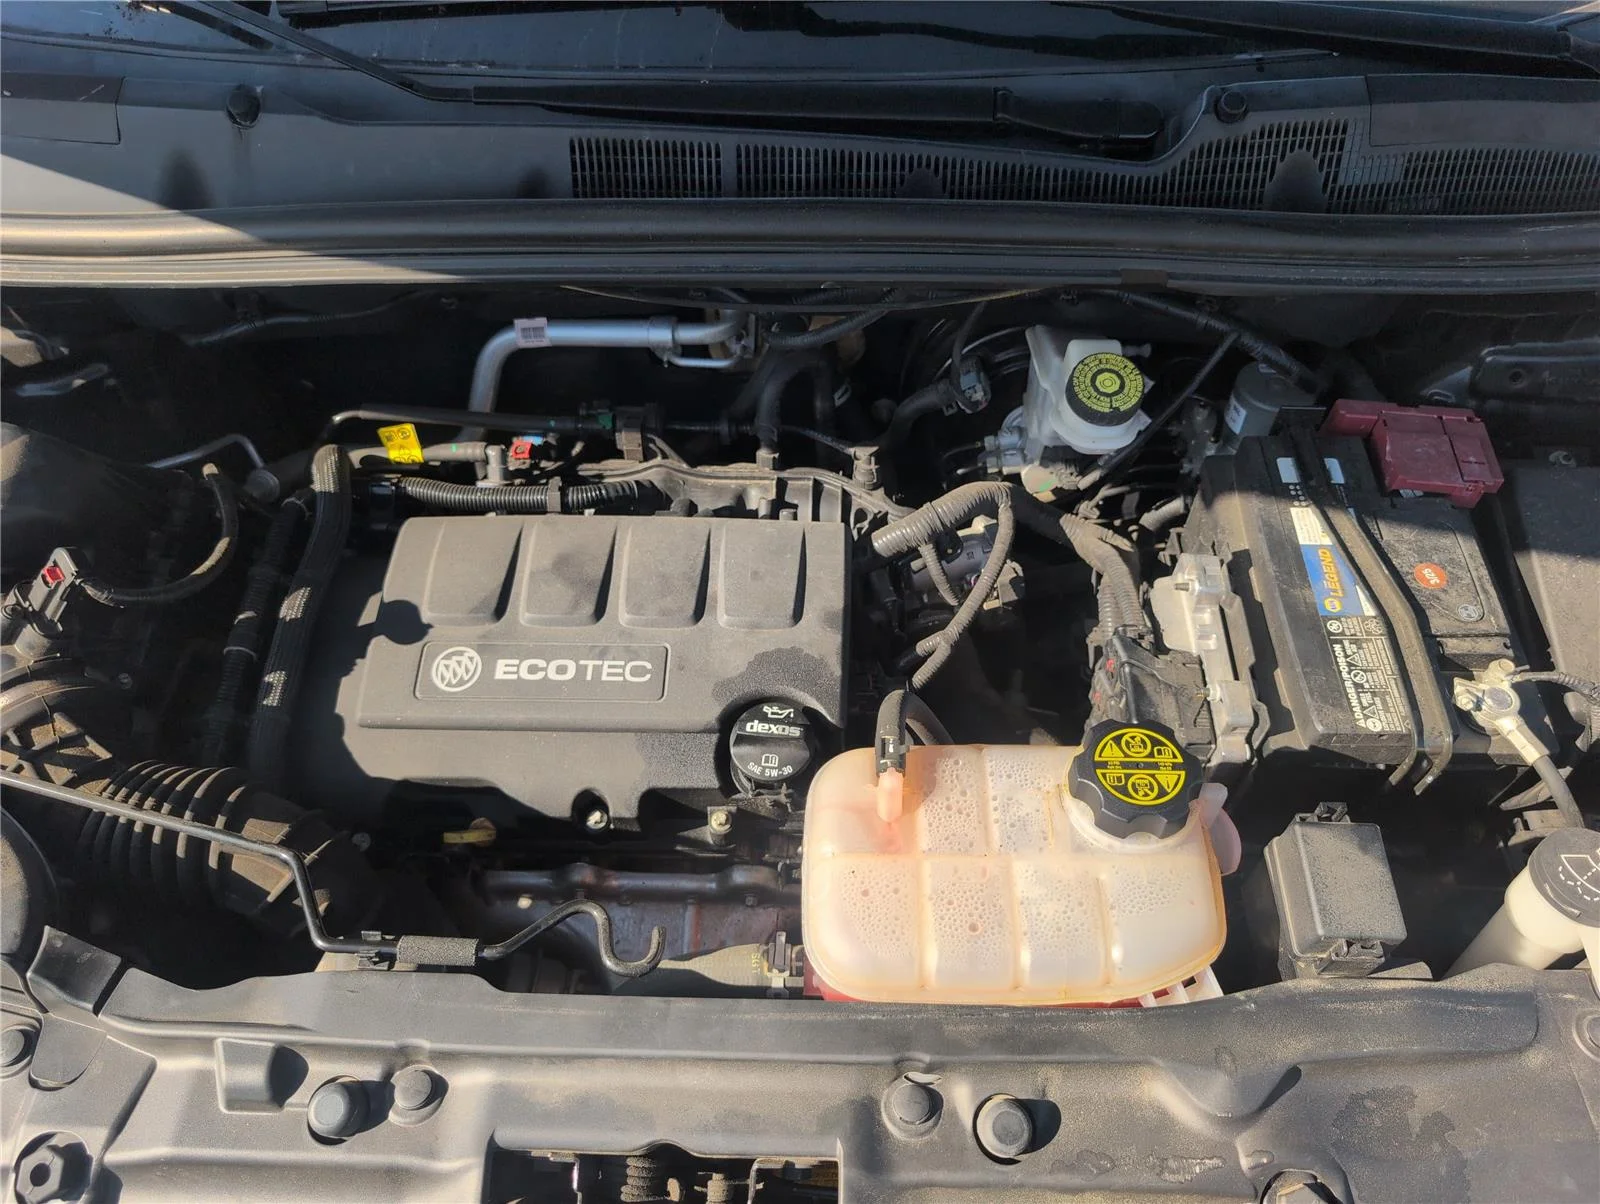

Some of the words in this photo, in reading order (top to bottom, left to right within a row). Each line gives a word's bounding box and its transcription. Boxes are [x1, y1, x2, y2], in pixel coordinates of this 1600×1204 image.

[1318, 548, 1343, 597] LEGEND
[494, 659, 652, 682] ECOTEC
[1333, 644, 1363, 718] DANGER/POISON
[746, 720, 801, 737] dexos
[748, 762, 763, 775] SAE
[765, 765, 793, 777] 5W-30
